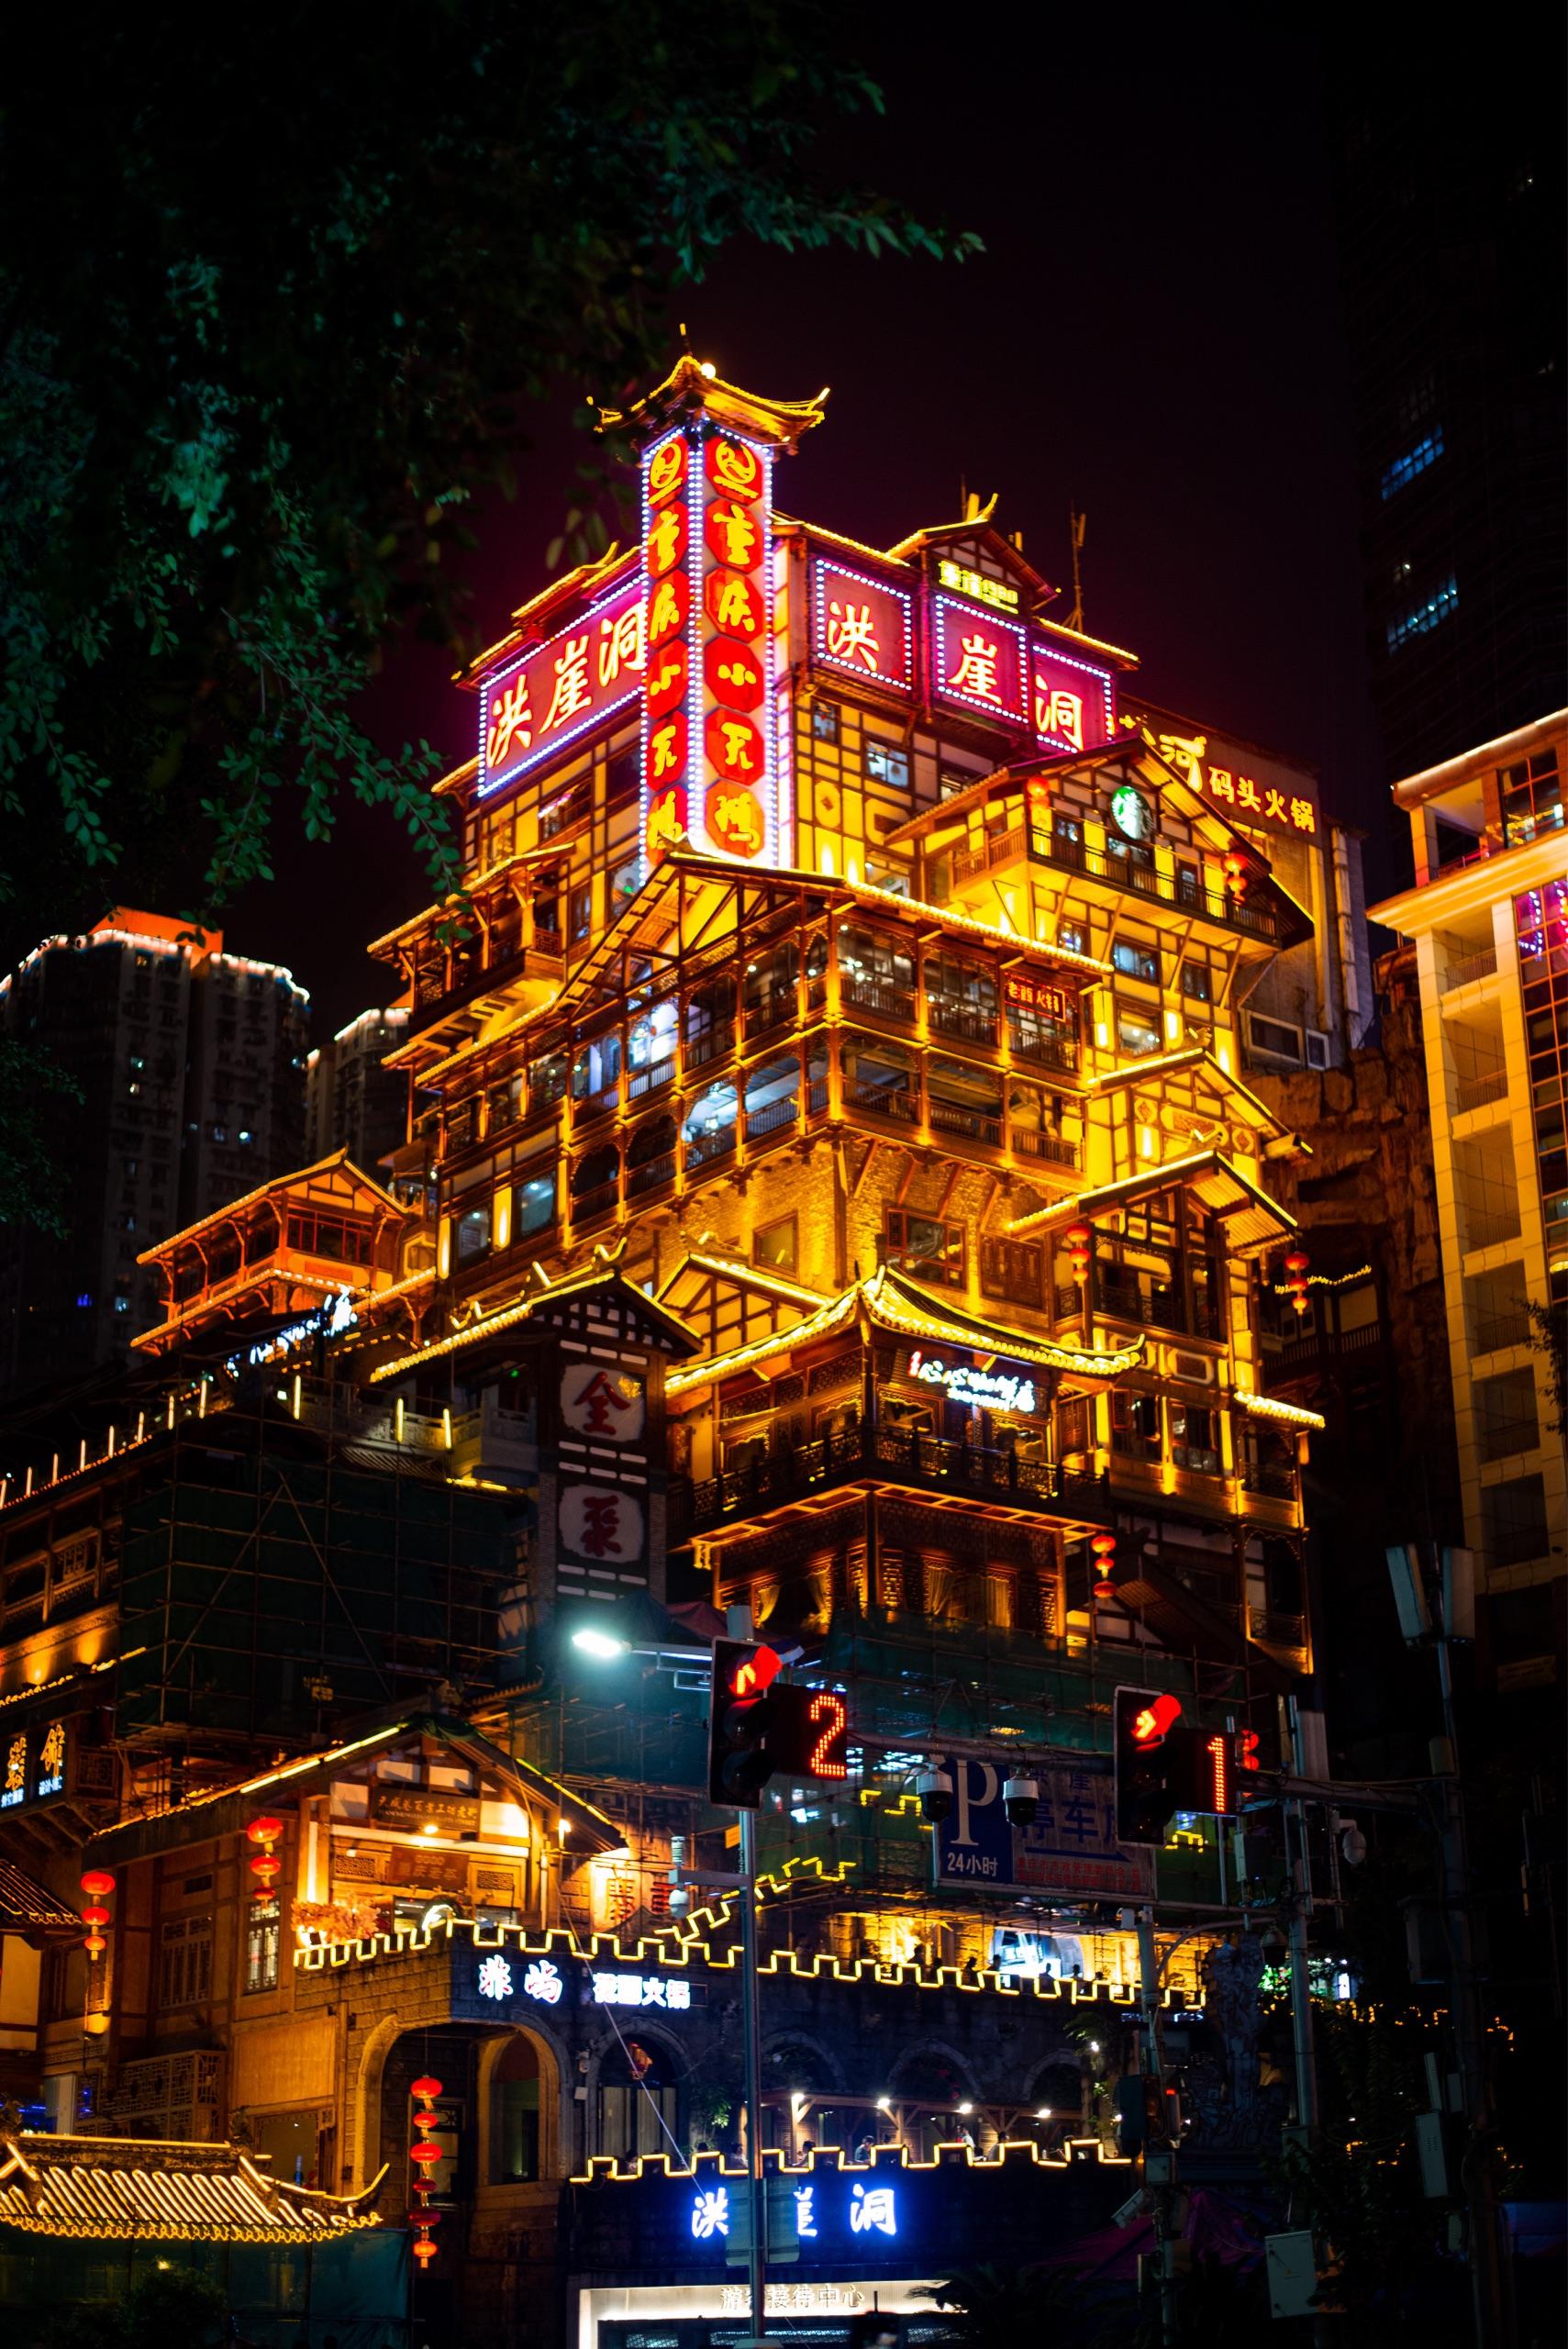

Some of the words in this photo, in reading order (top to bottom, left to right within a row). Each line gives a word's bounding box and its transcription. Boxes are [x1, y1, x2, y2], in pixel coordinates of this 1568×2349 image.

[485, 601, 646, 768] 洪崖洞
[713, 505, 761, 851] 重庆小天鹅
[828, 600, 1084, 753] 洪崖洞
[1208, 766, 1316, 833] 码头火锅
[811, 1695, 845, 1777] 2
[1207, 1736, 1225, 1812] 1
[951, 1759, 998, 1846] P
[1021, 1795, 1114, 1843] 停车
[947, 1852, 998, 1877] 24小时
